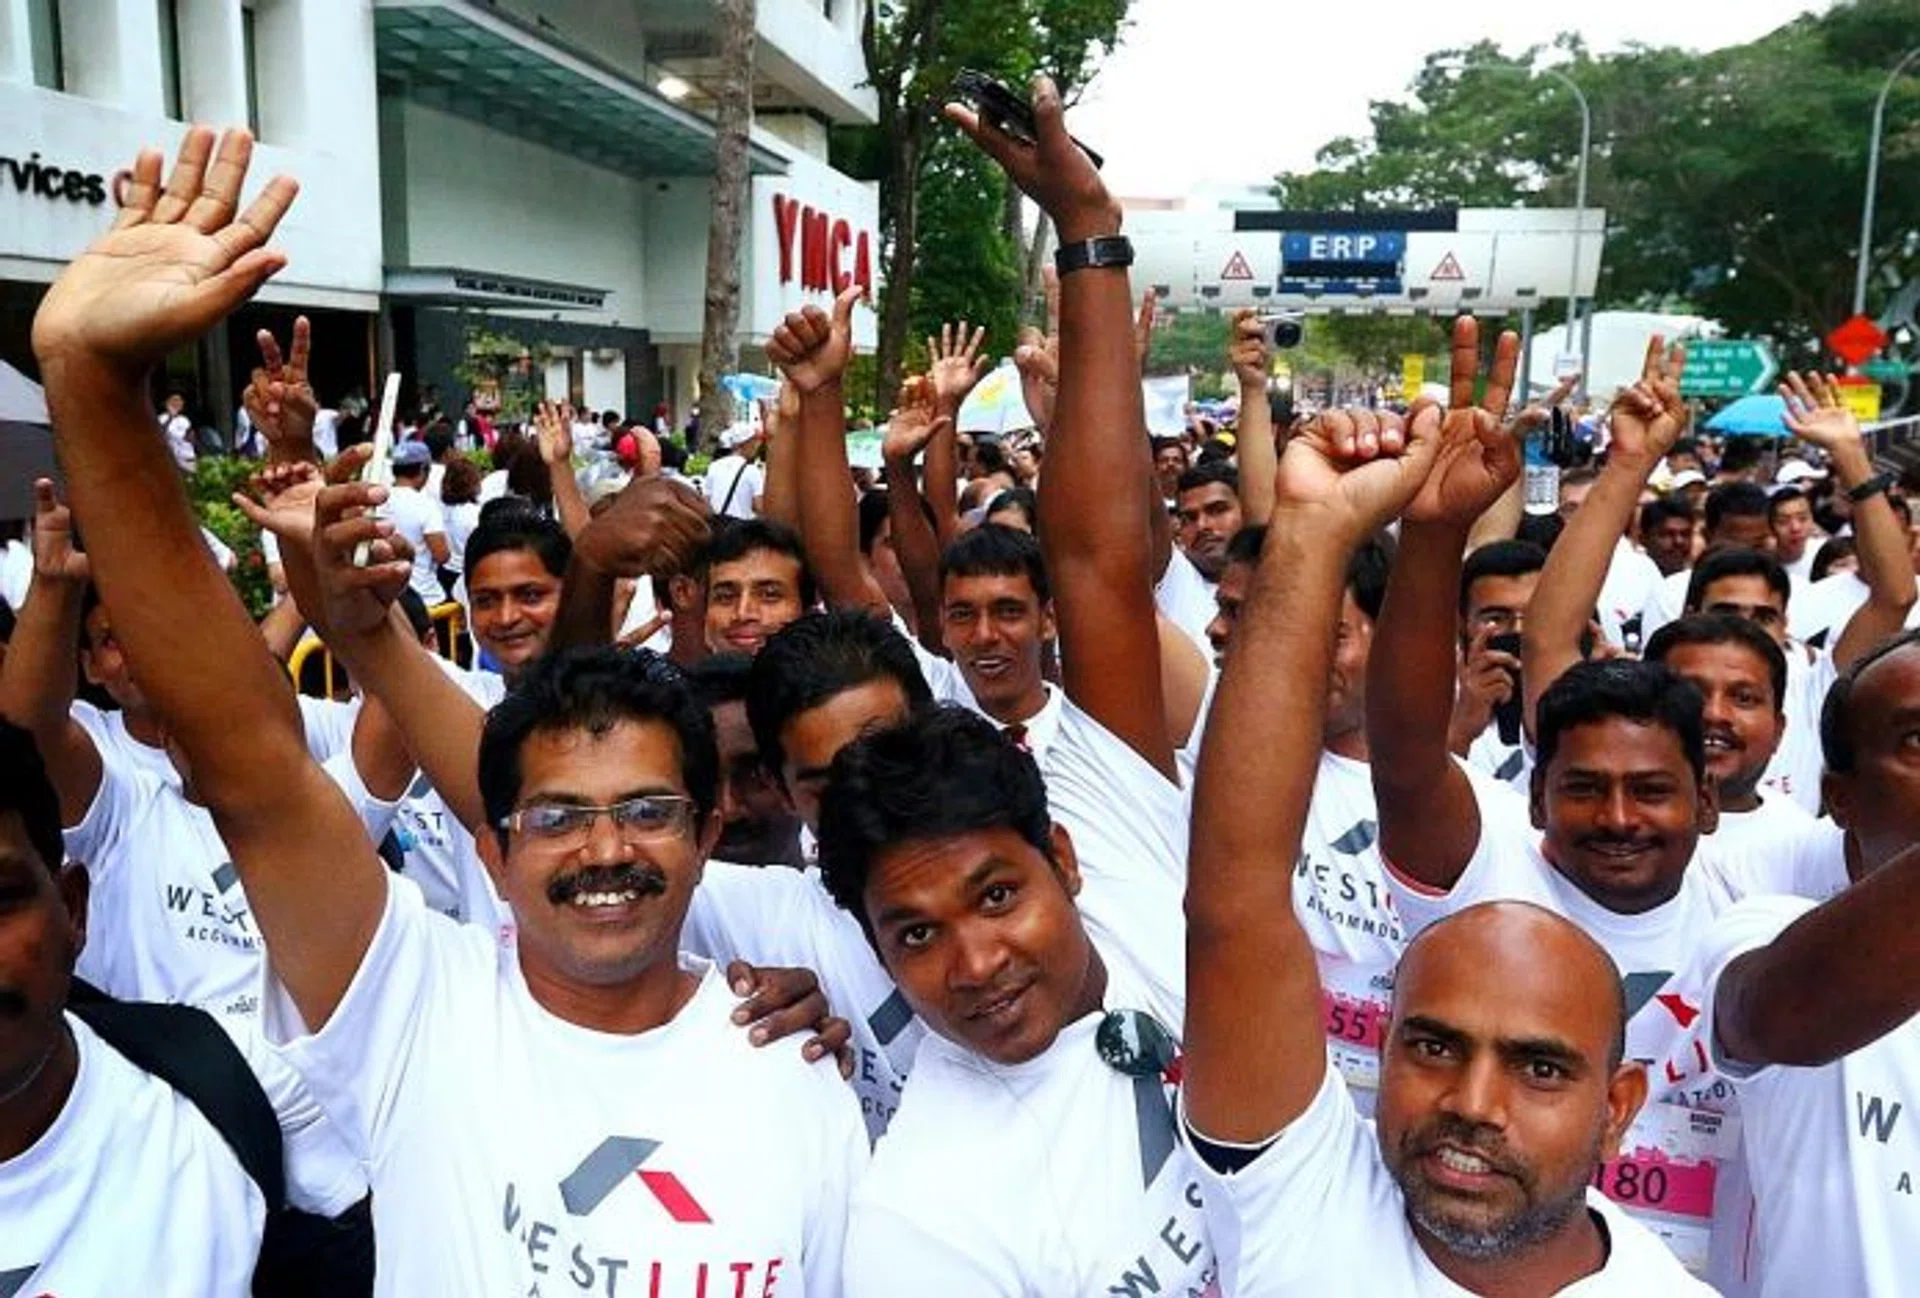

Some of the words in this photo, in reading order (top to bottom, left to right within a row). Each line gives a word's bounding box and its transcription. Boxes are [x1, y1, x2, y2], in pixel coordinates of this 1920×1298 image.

[773, 192, 871, 301] YMCA
[1309, 235, 1377, 259] ERP
[1856, 1090, 1902, 1143] W
